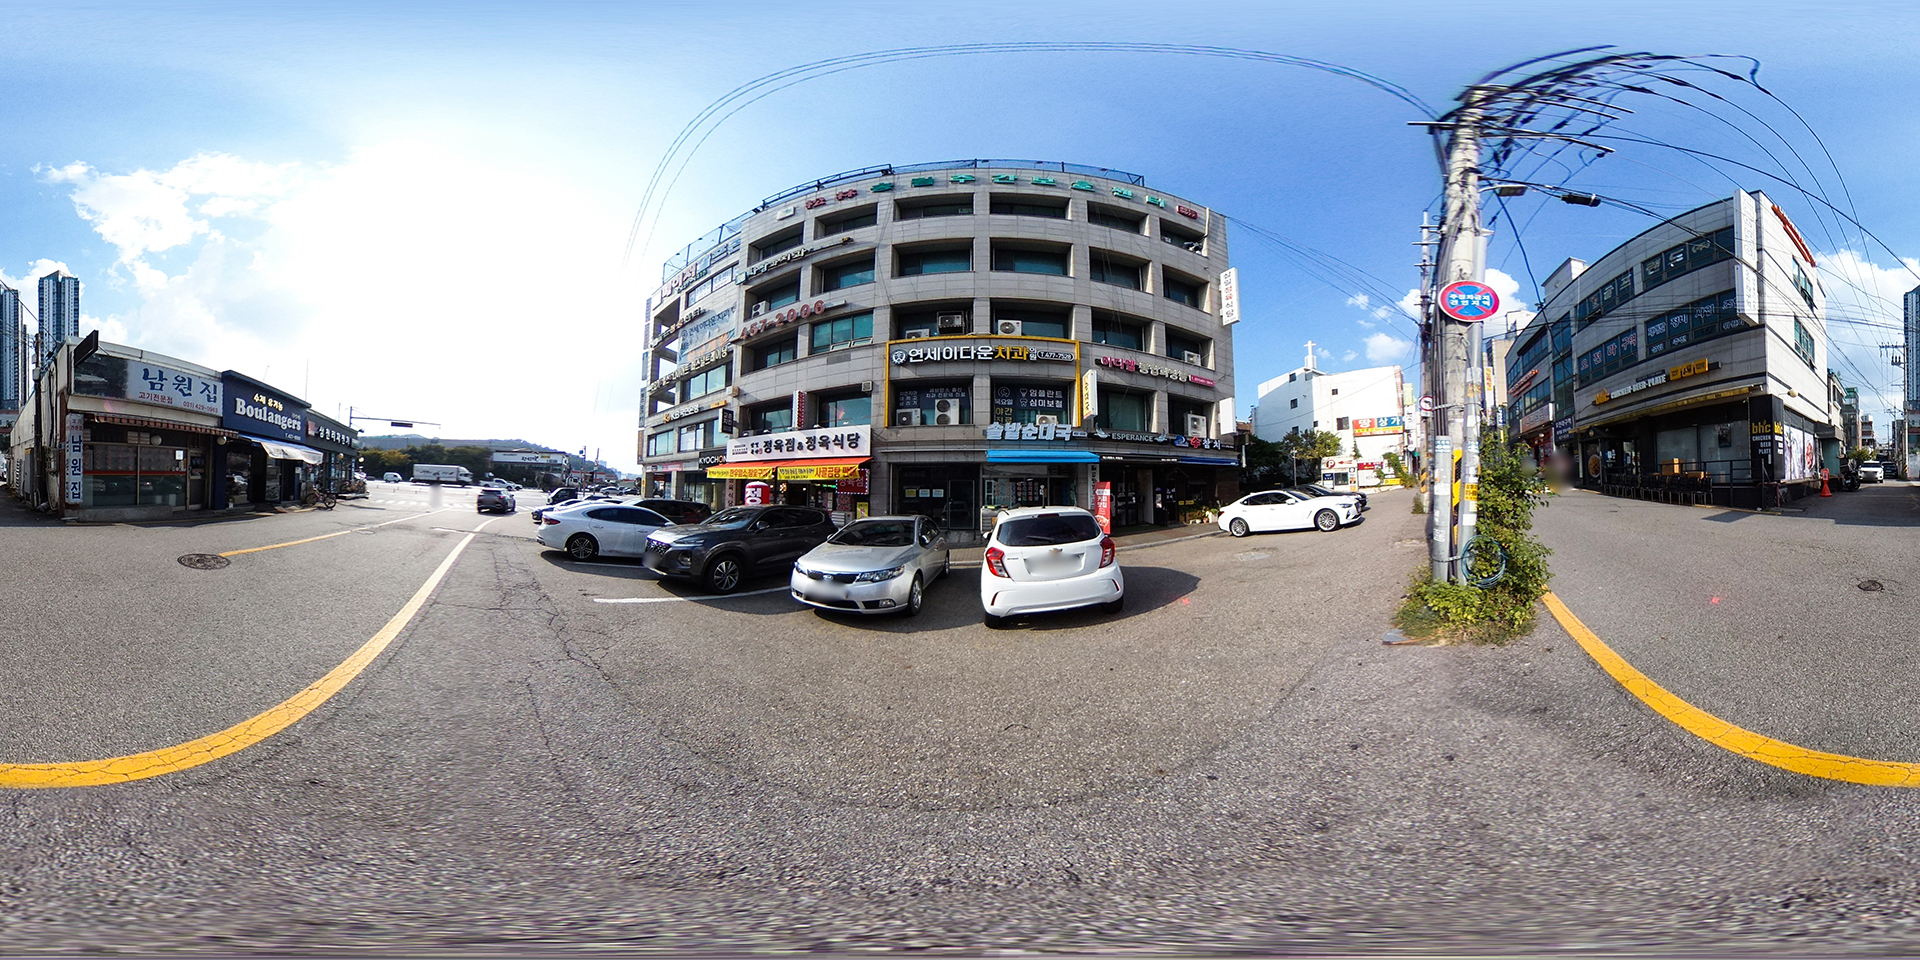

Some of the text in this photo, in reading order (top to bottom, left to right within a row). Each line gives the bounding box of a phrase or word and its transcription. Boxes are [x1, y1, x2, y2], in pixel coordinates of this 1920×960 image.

[909, 346, 1028, 362] 연세이다운치과
[142, 368, 217, 404] 남원집
[139, 392, 172, 404] 고기전문점
[1030, 389, 1062, 398] 임플란트
[1030, 399, 1062, 408] 심미보철
[236, 398, 301, 430] Boulangers
[996, 408, 1013, 416] 야간
[1358, 417, 1400, 428] 땅 상가
[1752, 420, 1771, 434] bhc
[1112, 433, 1154, 442] ESPERANCE
[70, 435, 82, 499] 남원집
